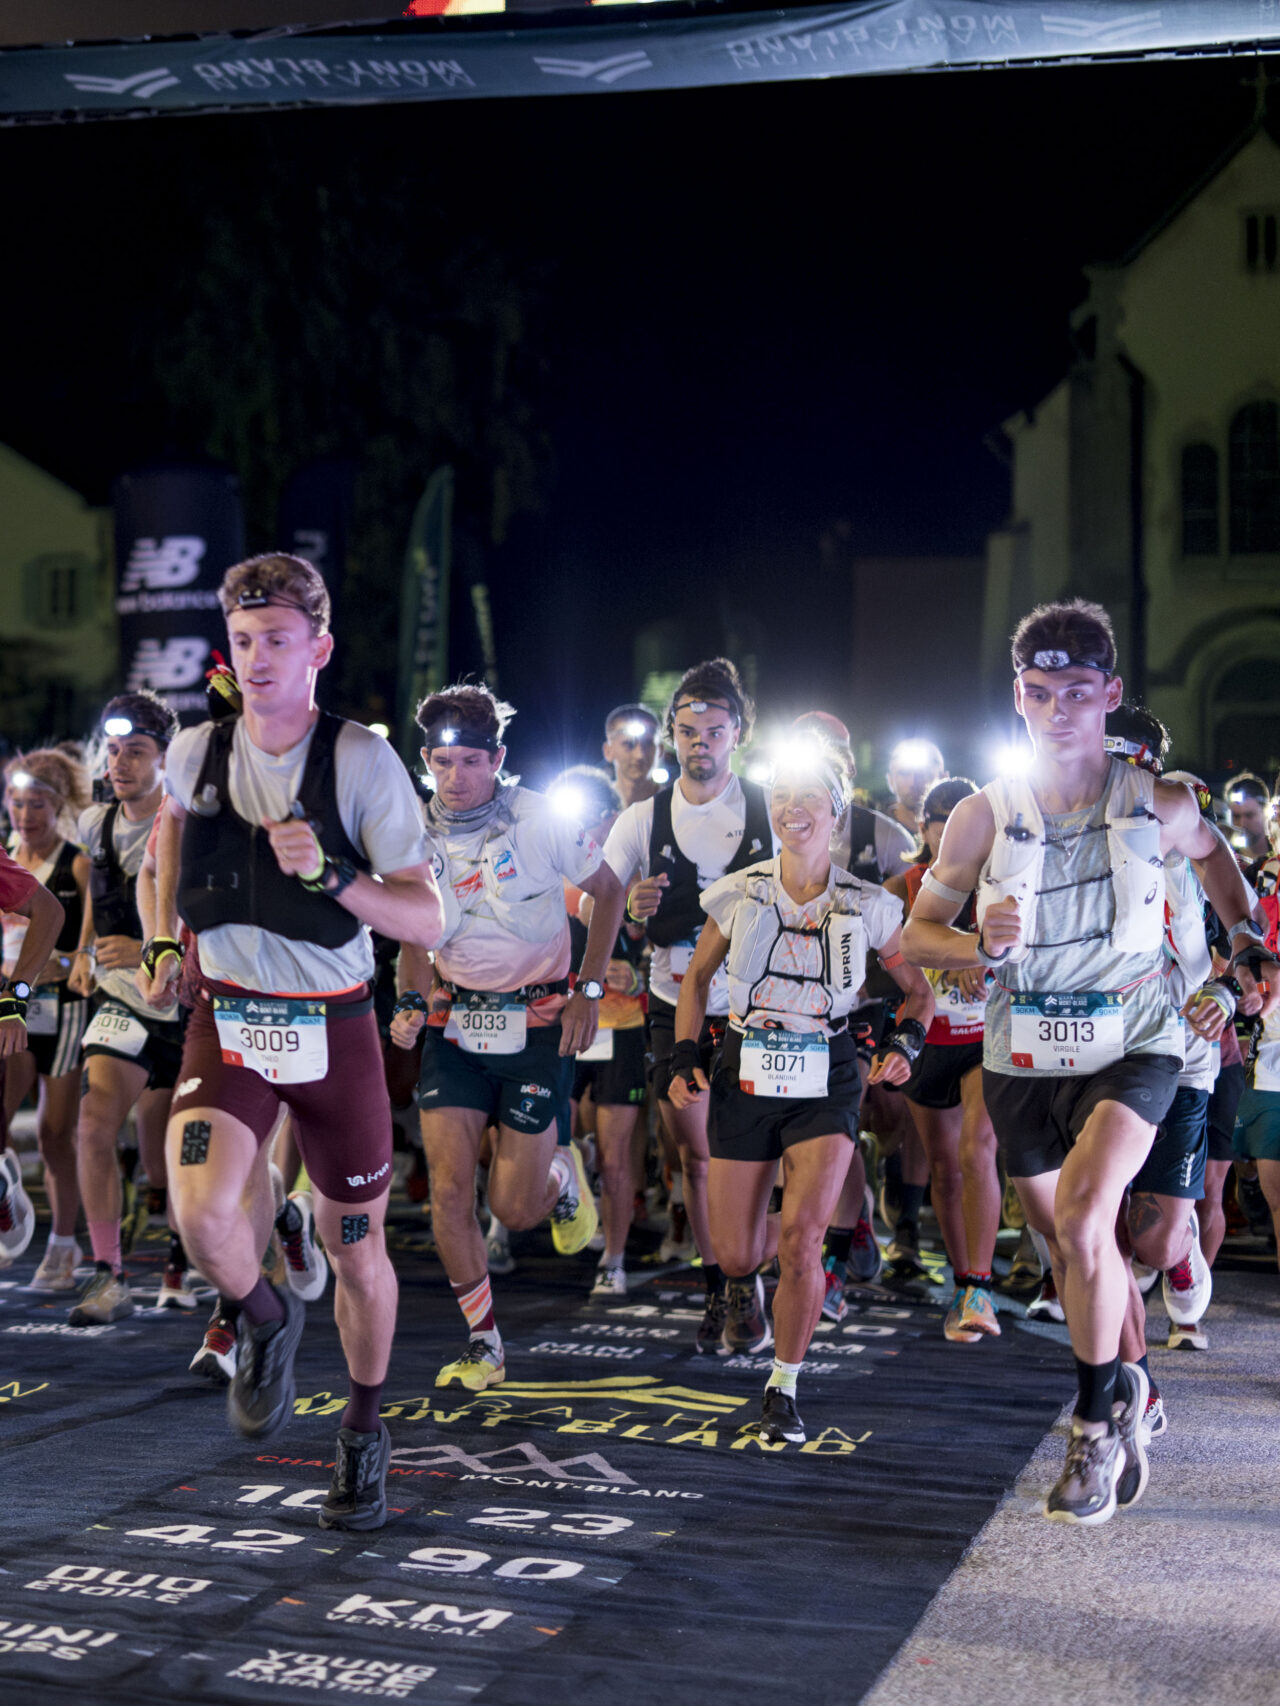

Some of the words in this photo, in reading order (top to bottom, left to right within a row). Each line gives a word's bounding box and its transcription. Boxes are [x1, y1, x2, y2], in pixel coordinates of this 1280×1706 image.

[724, 14, 1018, 58] MONT-BLANC
[191, 57, 467, 81] MONT-BLANC
[841, 932, 853, 991] KIPRUN
[462, 1013, 507, 1031] 3033
[1039, 1020, 1095, 1043] 3013
[240, 1027, 300, 1052] 3009
[1052, 1045, 1081, 1053] VIRGILE
[761, 1053, 805, 1073] 3071
[255, 1455, 705, 1500] CHANIX-MONT-BLANC
[466, 1507, 635, 1536] 23
[124, 1523, 306, 1554] 42
[397, 1547, 585, 1580] 90
[45, 1564, 214, 1593] DUO
[325, 1612, 486, 1638] VERTICAL
[332, 1593, 514, 1630] KM
[238, 1658, 428, 1690] RACE
[267, 1649, 438, 1678] YOUNG
[224, 1669, 411, 1699] MARATHON
